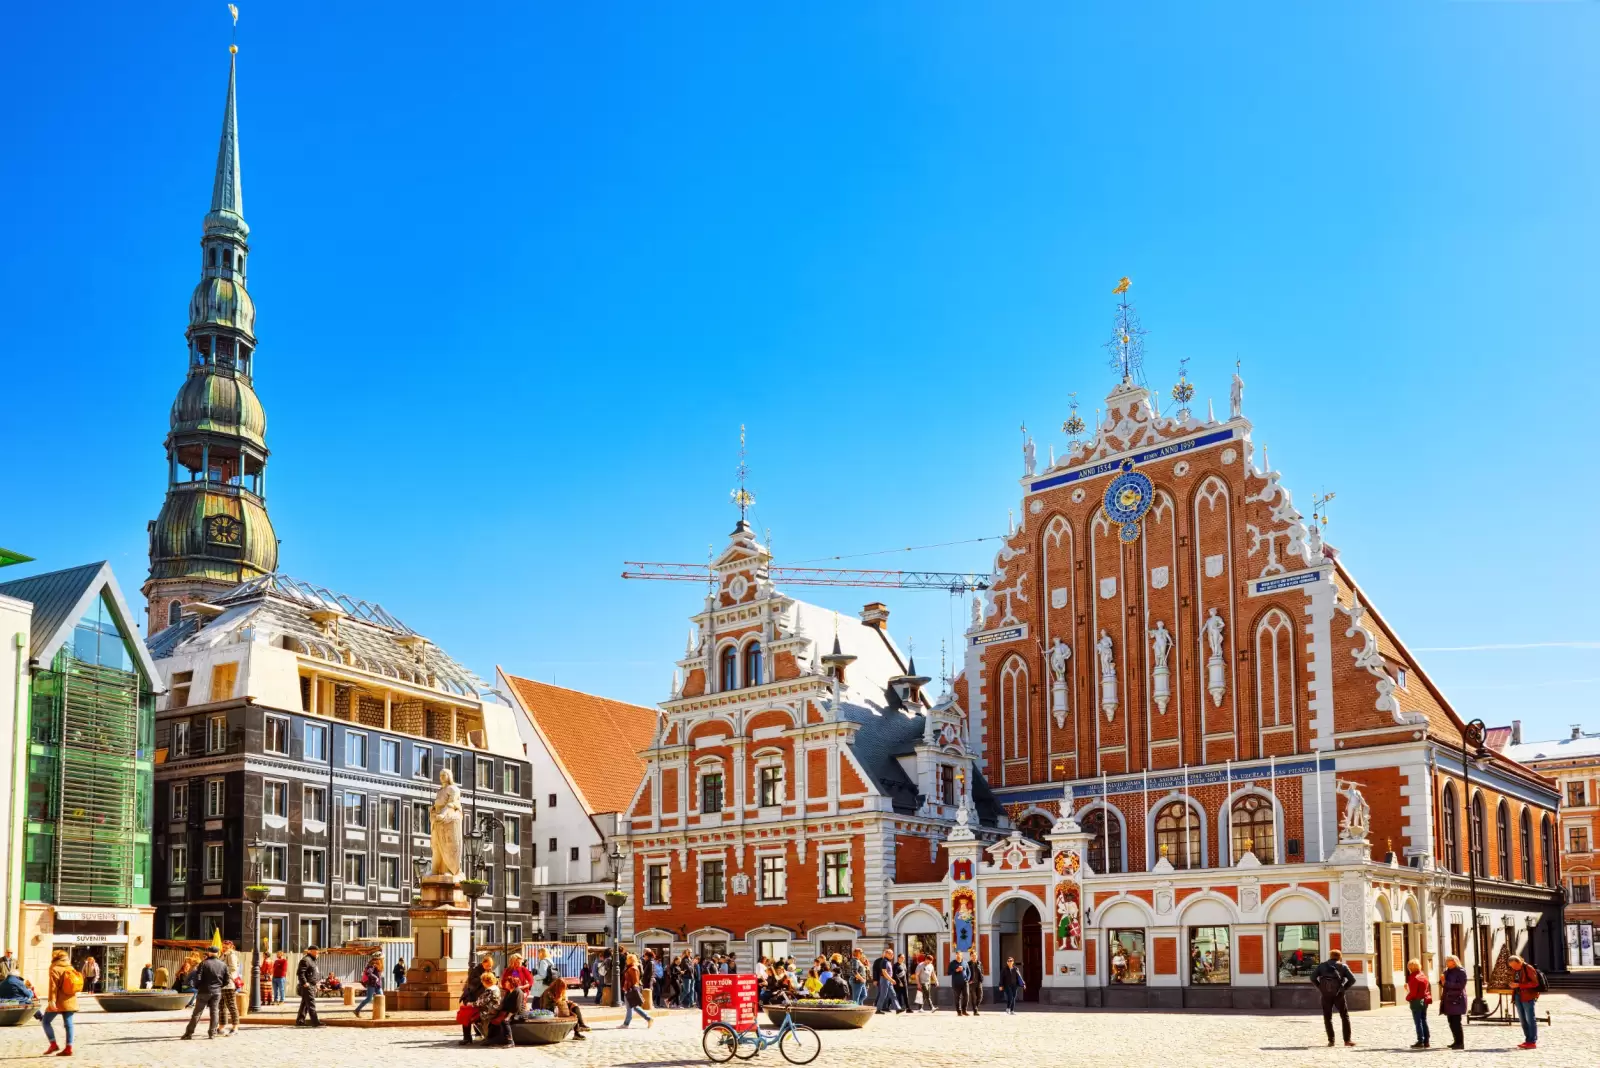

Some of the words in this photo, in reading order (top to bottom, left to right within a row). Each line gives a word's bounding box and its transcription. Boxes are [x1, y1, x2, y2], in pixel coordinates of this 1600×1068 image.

[1078, 467, 1096, 478] ANNO
[1159, 445, 1178, 457] ANNO
[1266, 769, 1286, 777] RGAS
